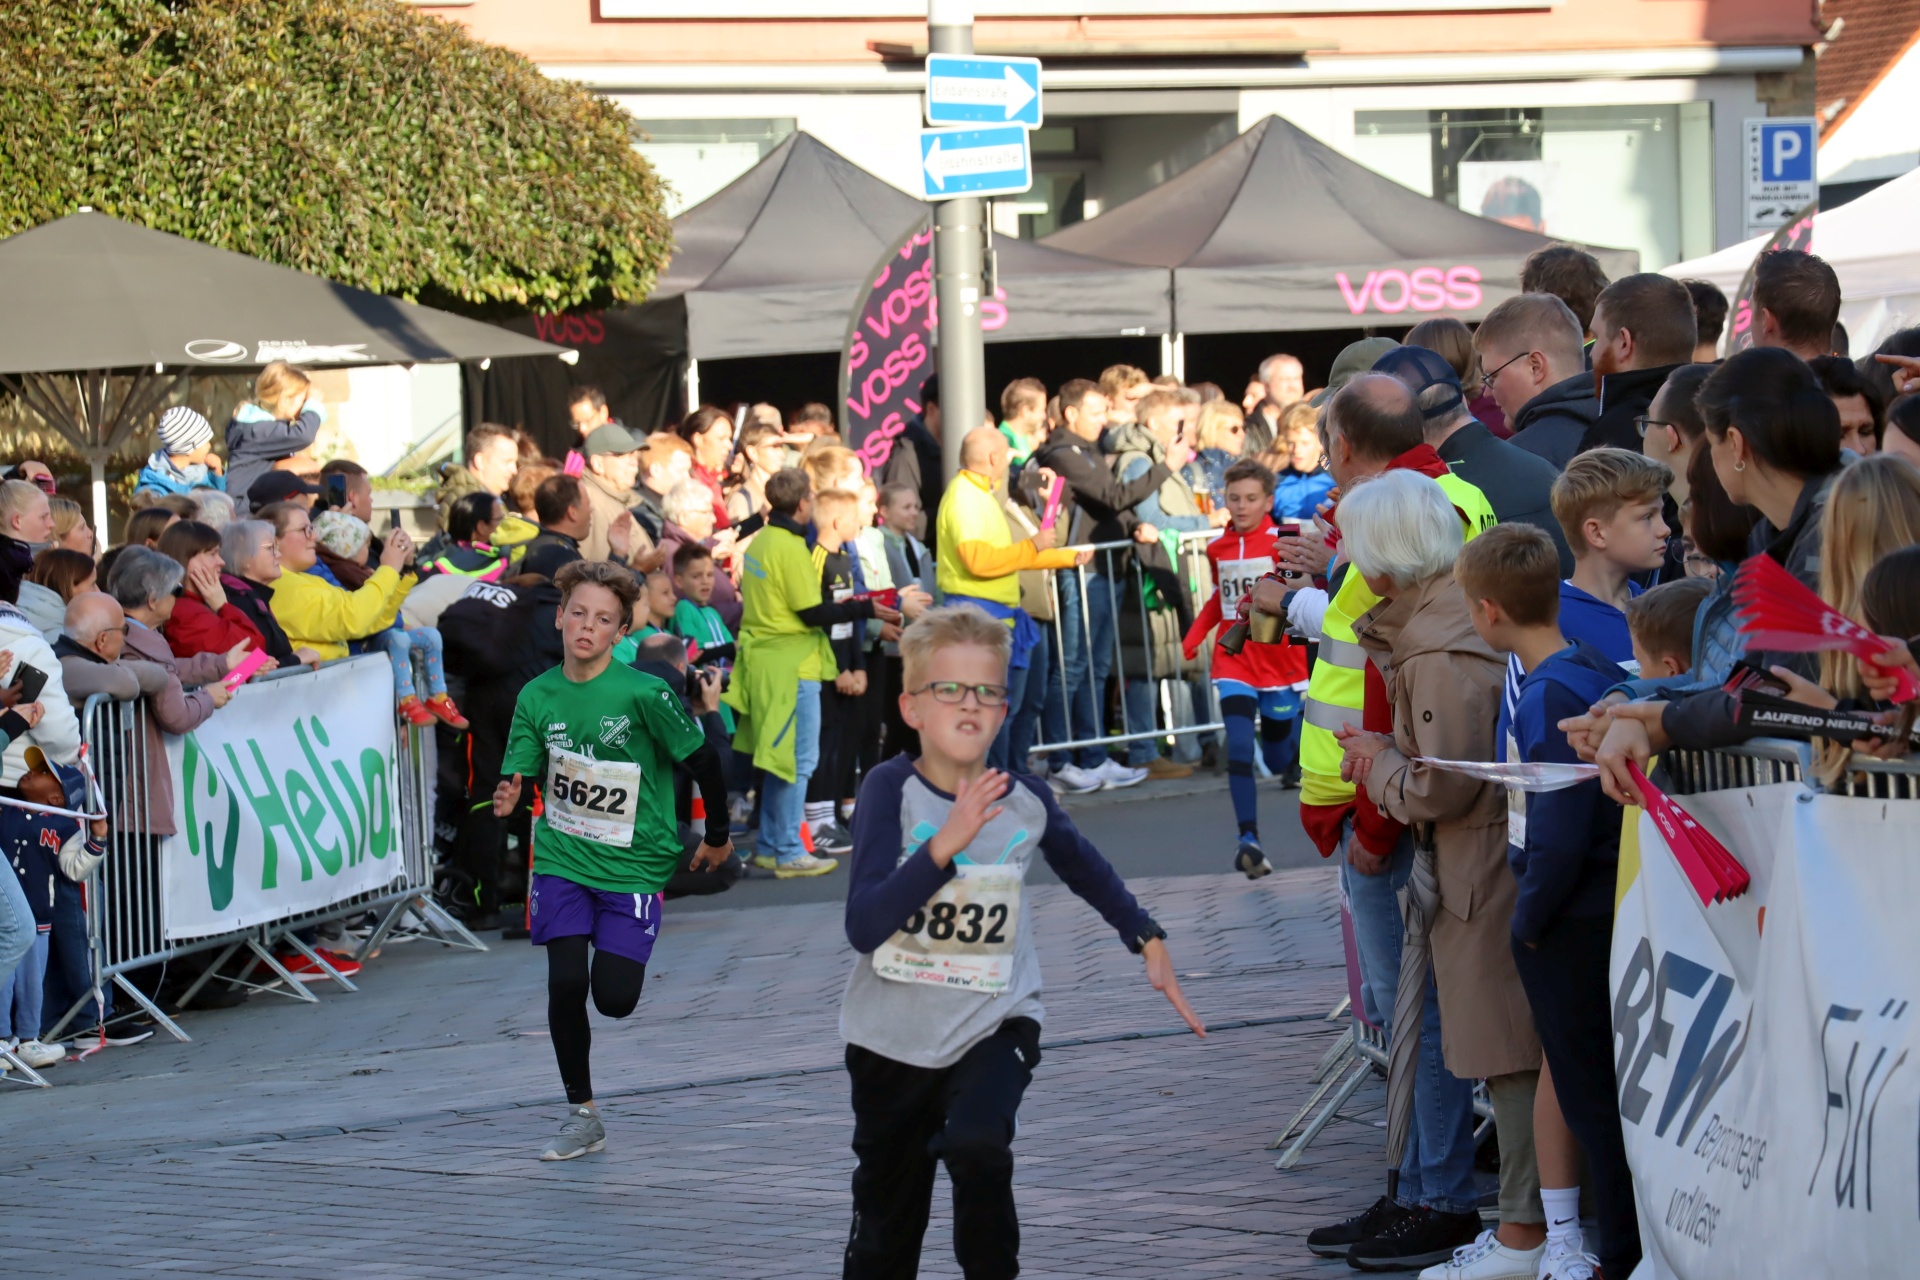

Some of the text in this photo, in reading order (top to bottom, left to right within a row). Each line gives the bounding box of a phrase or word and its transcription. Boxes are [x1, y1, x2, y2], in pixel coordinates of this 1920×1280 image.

[1773, 130, 1803, 178] P
[1335, 266, 1482, 314] VOSS
[533, 312, 605, 344] VOSS
[846, 333, 927, 419] VOSS
[463, 581, 518, 609] ANS
[547, 722, 567, 731] JAKO
[1753, 709, 1824, 727] LAUFEND
[1826, 718, 1868, 731] NEUE
[222, 714, 397, 890] Helio
[553, 773, 628, 815] 5622
[563, 825, 583, 836] VOSS
[583, 831, 600, 840] BEW
[1656, 805, 1676, 839] VOSS
[881, 965, 902, 976] AOK
[915, 971, 945, 984] VOSS
[947, 976, 973, 986] BEW
[1808, 998, 1909, 1212] Für
